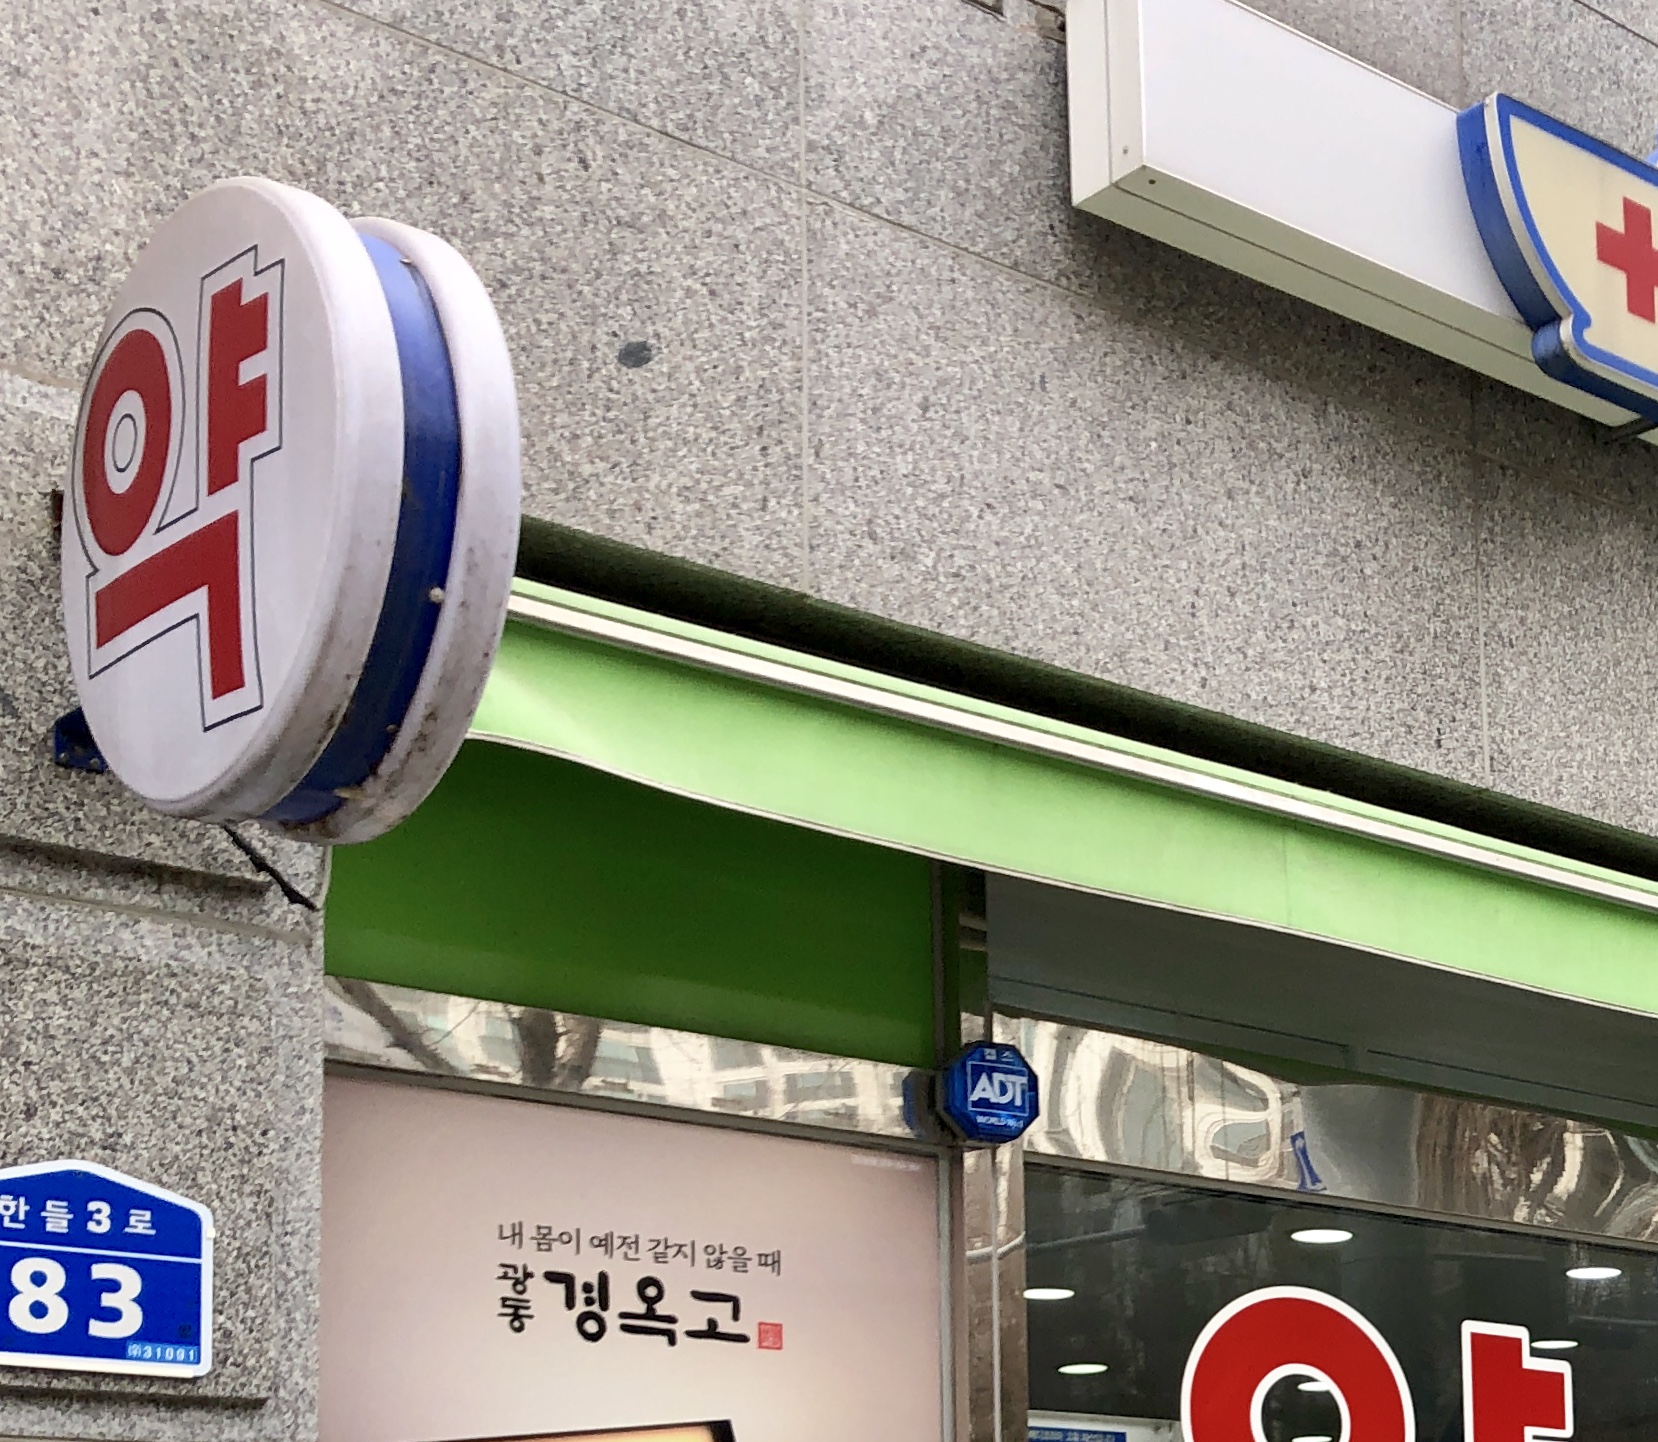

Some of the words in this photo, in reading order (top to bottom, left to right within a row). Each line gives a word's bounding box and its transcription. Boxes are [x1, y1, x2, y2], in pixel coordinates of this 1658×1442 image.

[83, 258, 278, 714] 약
[969, 1071, 1029, 1107] ADT
[0, 1193, 157, 1237] 한들3로
[498, 1221, 523, 1249] 내
[530, 1224, 581, 1255] 몸이
[589, 1230, 640, 1261] 예전
[647, 1237, 696, 1267] 같지
[703, 1242, 753, 1273] 않을
[757, 1249, 782, 1276] 때
[8, 1256, 145, 1340] 83
[496, 1263, 534, 1333] 광동
[543, 1270, 751, 1347] 경옥고
